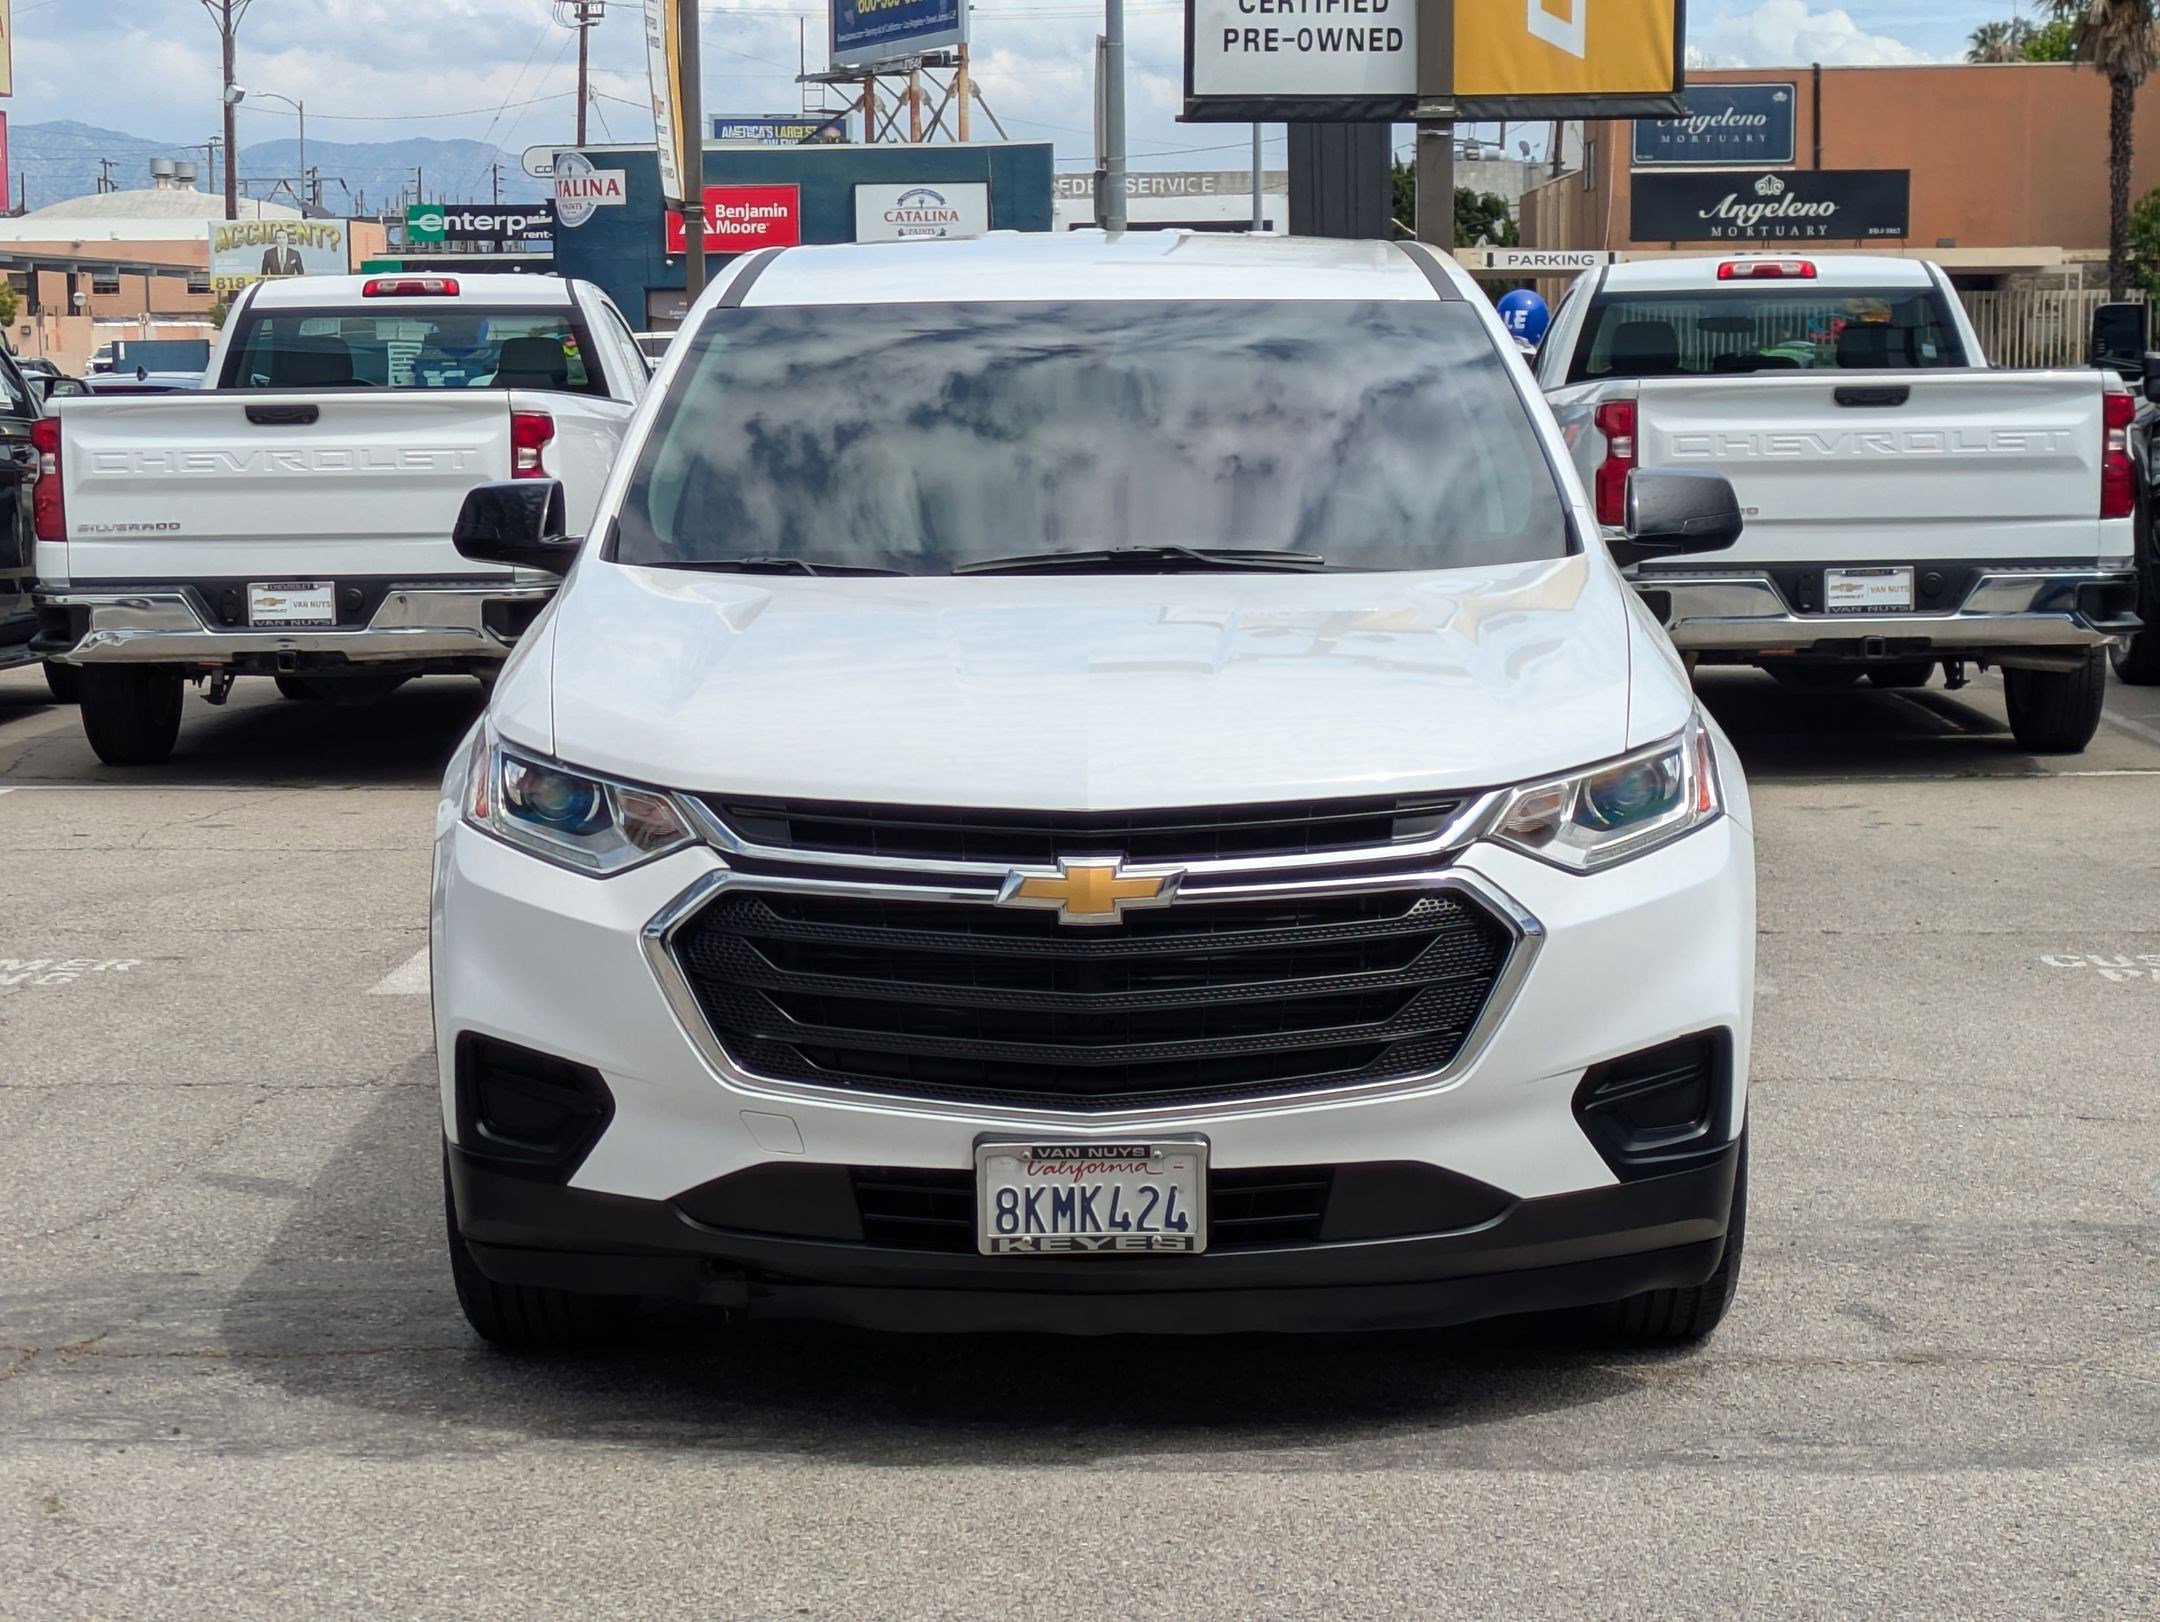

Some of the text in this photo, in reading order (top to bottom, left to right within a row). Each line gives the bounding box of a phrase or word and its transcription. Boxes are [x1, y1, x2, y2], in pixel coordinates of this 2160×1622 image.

[1223, 28, 1404, 52] PRE-OWNED
[1661, 134, 1767, 144] MORTUARY
[1126, 177, 1215, 194] SERVICE
[715, 203, 788, 221] Benjamin
[884, 210, 960, 223] CATALINA
[1699, 192, 1840, 227] Angeleno
[716, 220, 767, 234] Moore
[1711, 226, 1828, 237] MORTUARY
[214, 219, 342, 253] ACCIDENT?
[1508, 254, 1595, 267] PARKING
[1671, 430, 2072, 456] CHEVROLET
[91, 447, 478, 474] CHEVROLET
[78, 522, 181, 533] SILVERADO
[292, 600, 332, 609] VAN NUYS
[1831, 604, 1909, 614] VAN NUYS
[255, 618, 332, 627] VAN NUYS
[1037, 1147, 1146, 1159] VAN NUYS
[1026, 1160, 1164, 1183] California
[995, 1184, 1190, 1235] 8KMK424
[999, 1235, 1188, 1252] KEYES
